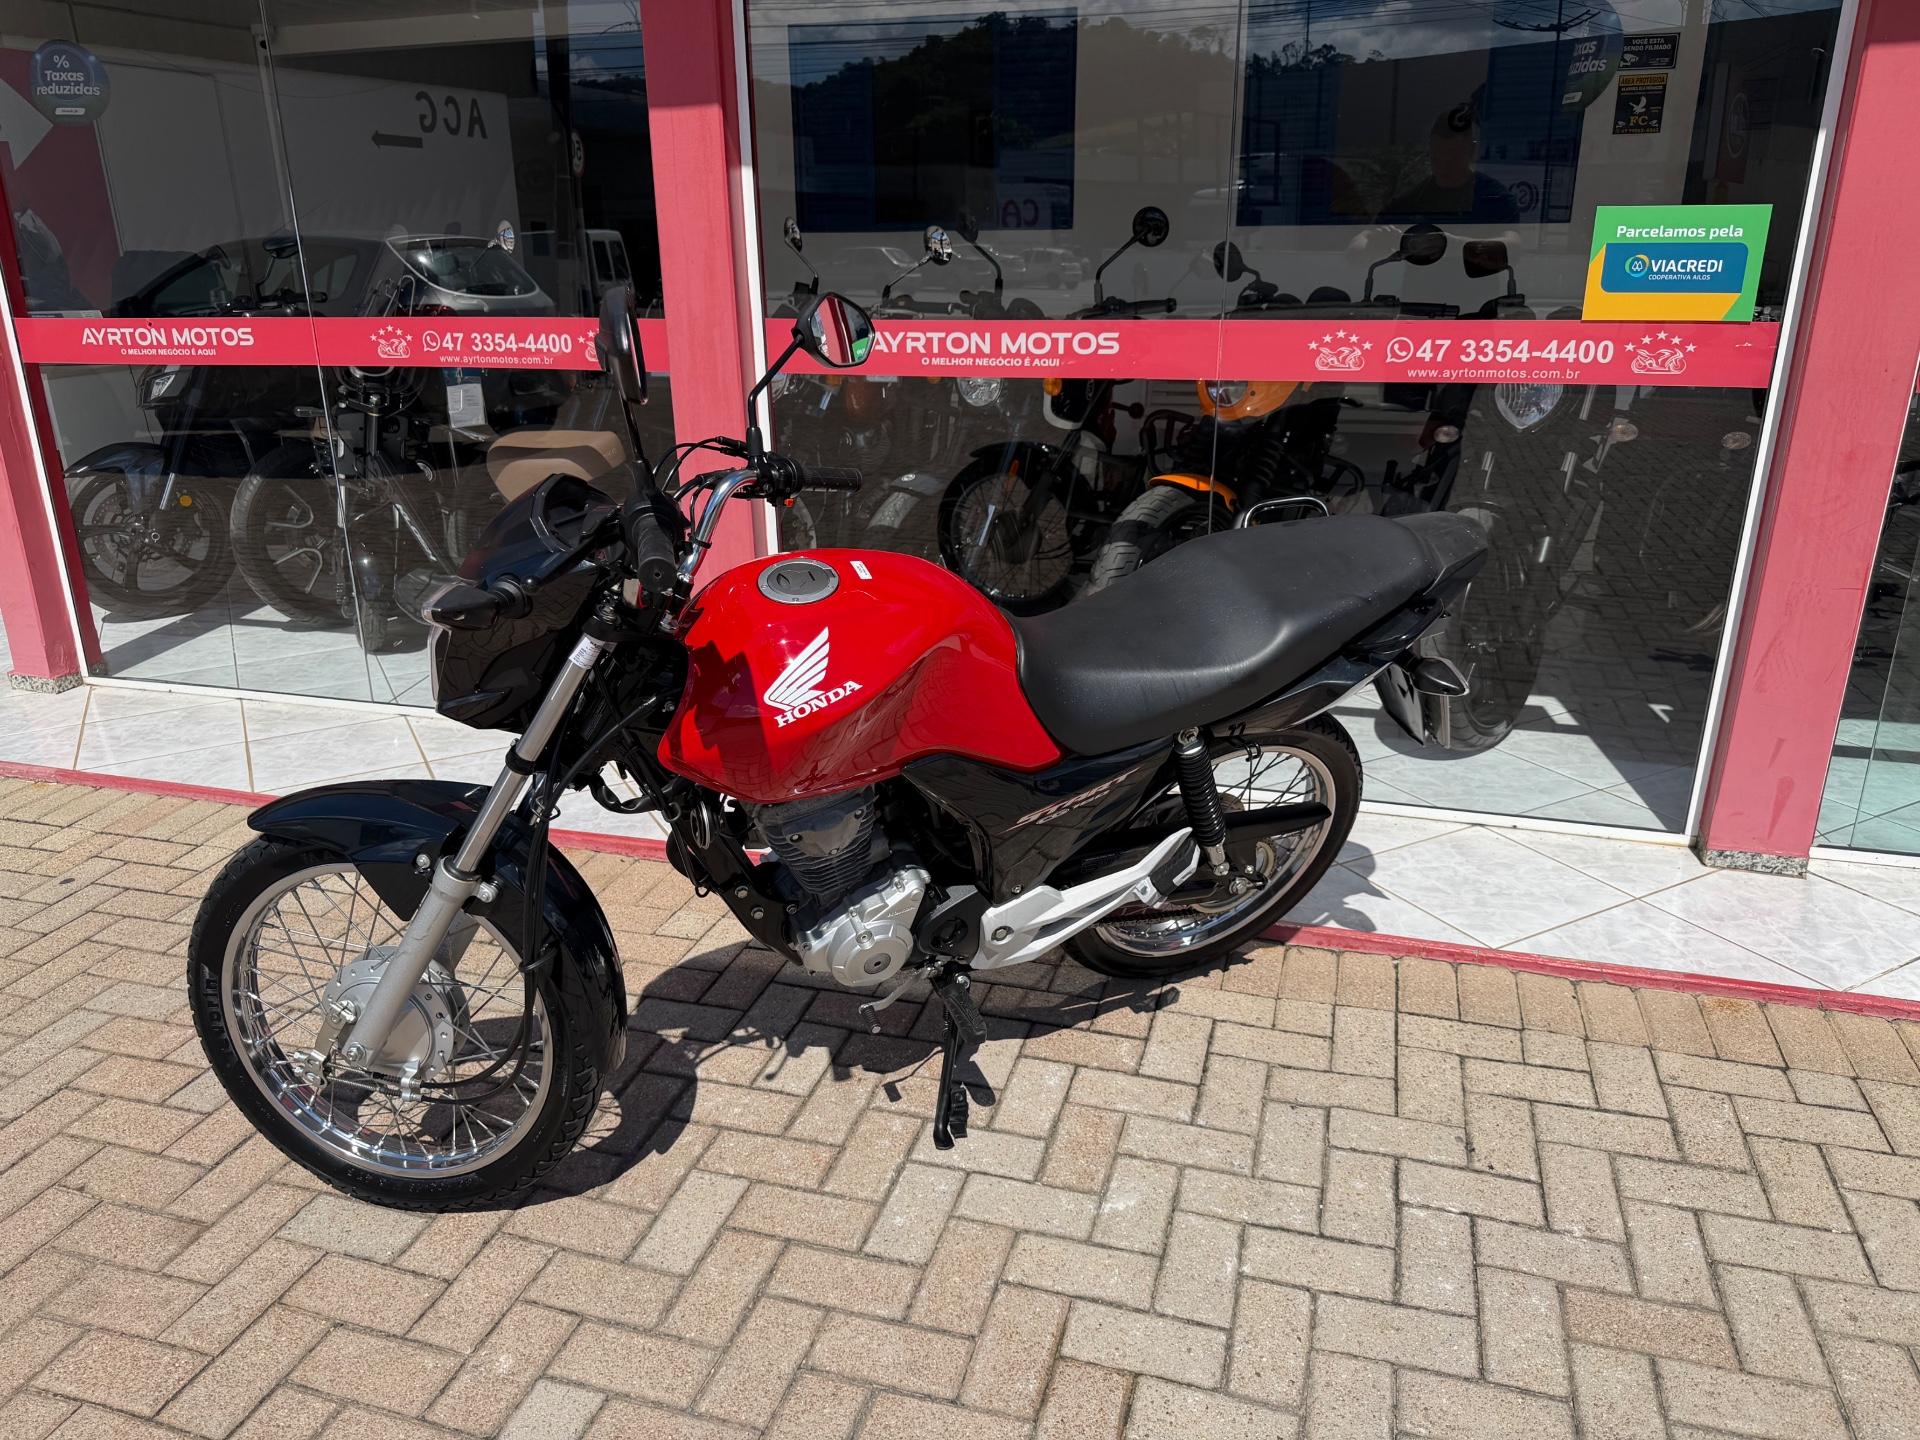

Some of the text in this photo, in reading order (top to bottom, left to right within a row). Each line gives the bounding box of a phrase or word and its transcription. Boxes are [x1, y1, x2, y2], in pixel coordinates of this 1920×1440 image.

[44, 70, 85, 82] Taxas
[36, 82, 101, 96] reduzidas
[1616, 225, 1744, 240] Parcelamos pela
[1651, 259, 1724, 273] VIACREDI
[81, 327, 255, 346] AYRTON MOTOS
[442, 332, 572, 353] 47 3354-4400
[873, 331, 1120, 355] AYRTON MOTOS
[127, 348, 157, 356] MELHOR
[157, 347, 191, 356] NEGÓCIO
[191, 347, 196, 356] É
[197, 348, 216, 356] AQUI
[1415, 339, 1614, 364] 47 3354-4400
[439, 353, 554, 366] www.ayrtonmotos.com.br
[921, 355, 1060, 367] O MELHOR NEGÓCIO É AQUI
[1407, 367, 1580, 380] www.ayrtonmotos.com.br
[774, 680, 863, 728] HONDA
